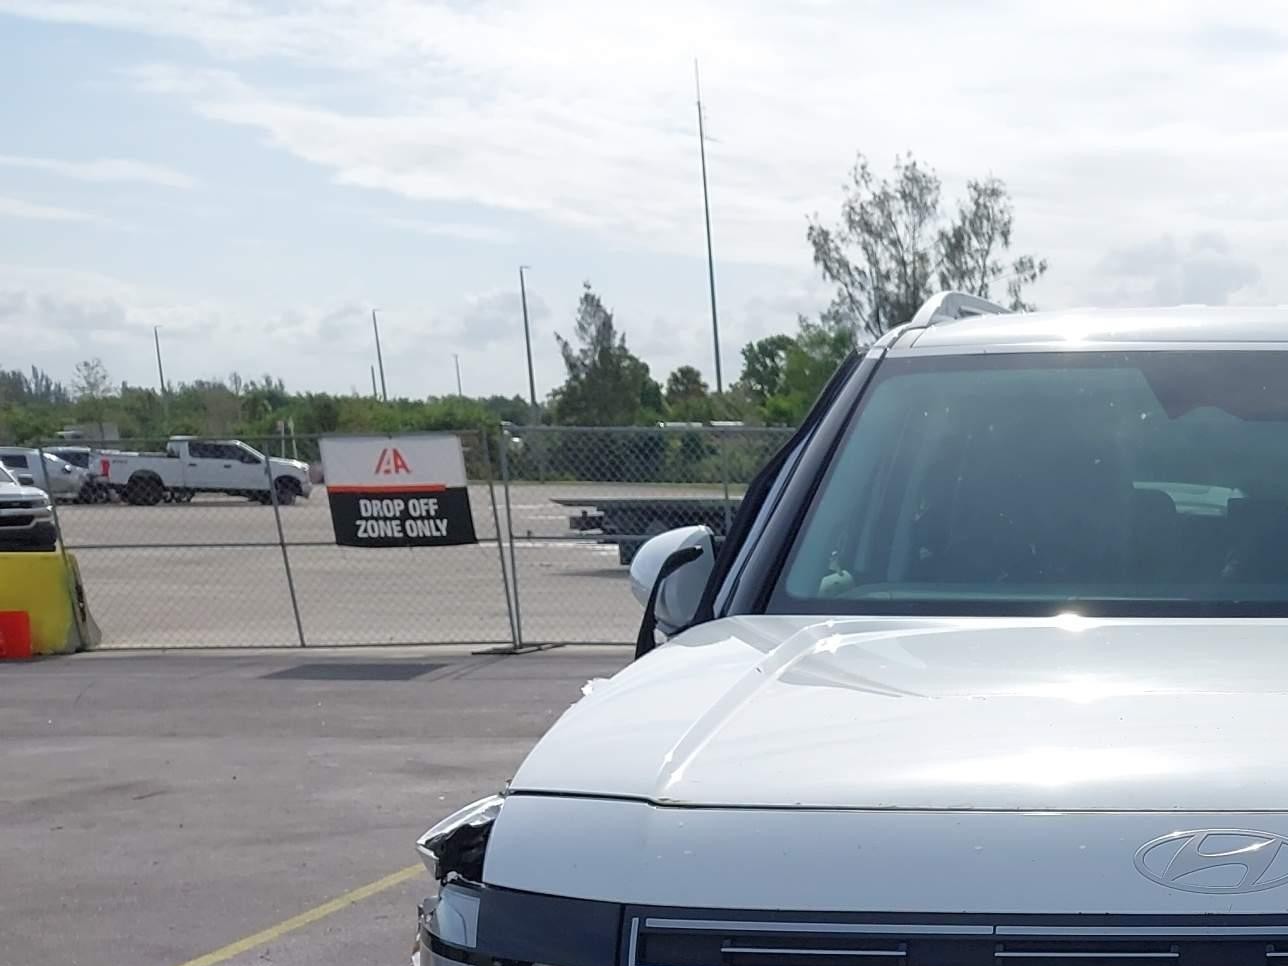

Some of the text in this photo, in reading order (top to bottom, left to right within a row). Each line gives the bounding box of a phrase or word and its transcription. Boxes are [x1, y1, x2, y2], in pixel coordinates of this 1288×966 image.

[359, 499, 439, 517] DROP OFF
[356, 519, 448, 538] ZONE ONLY
